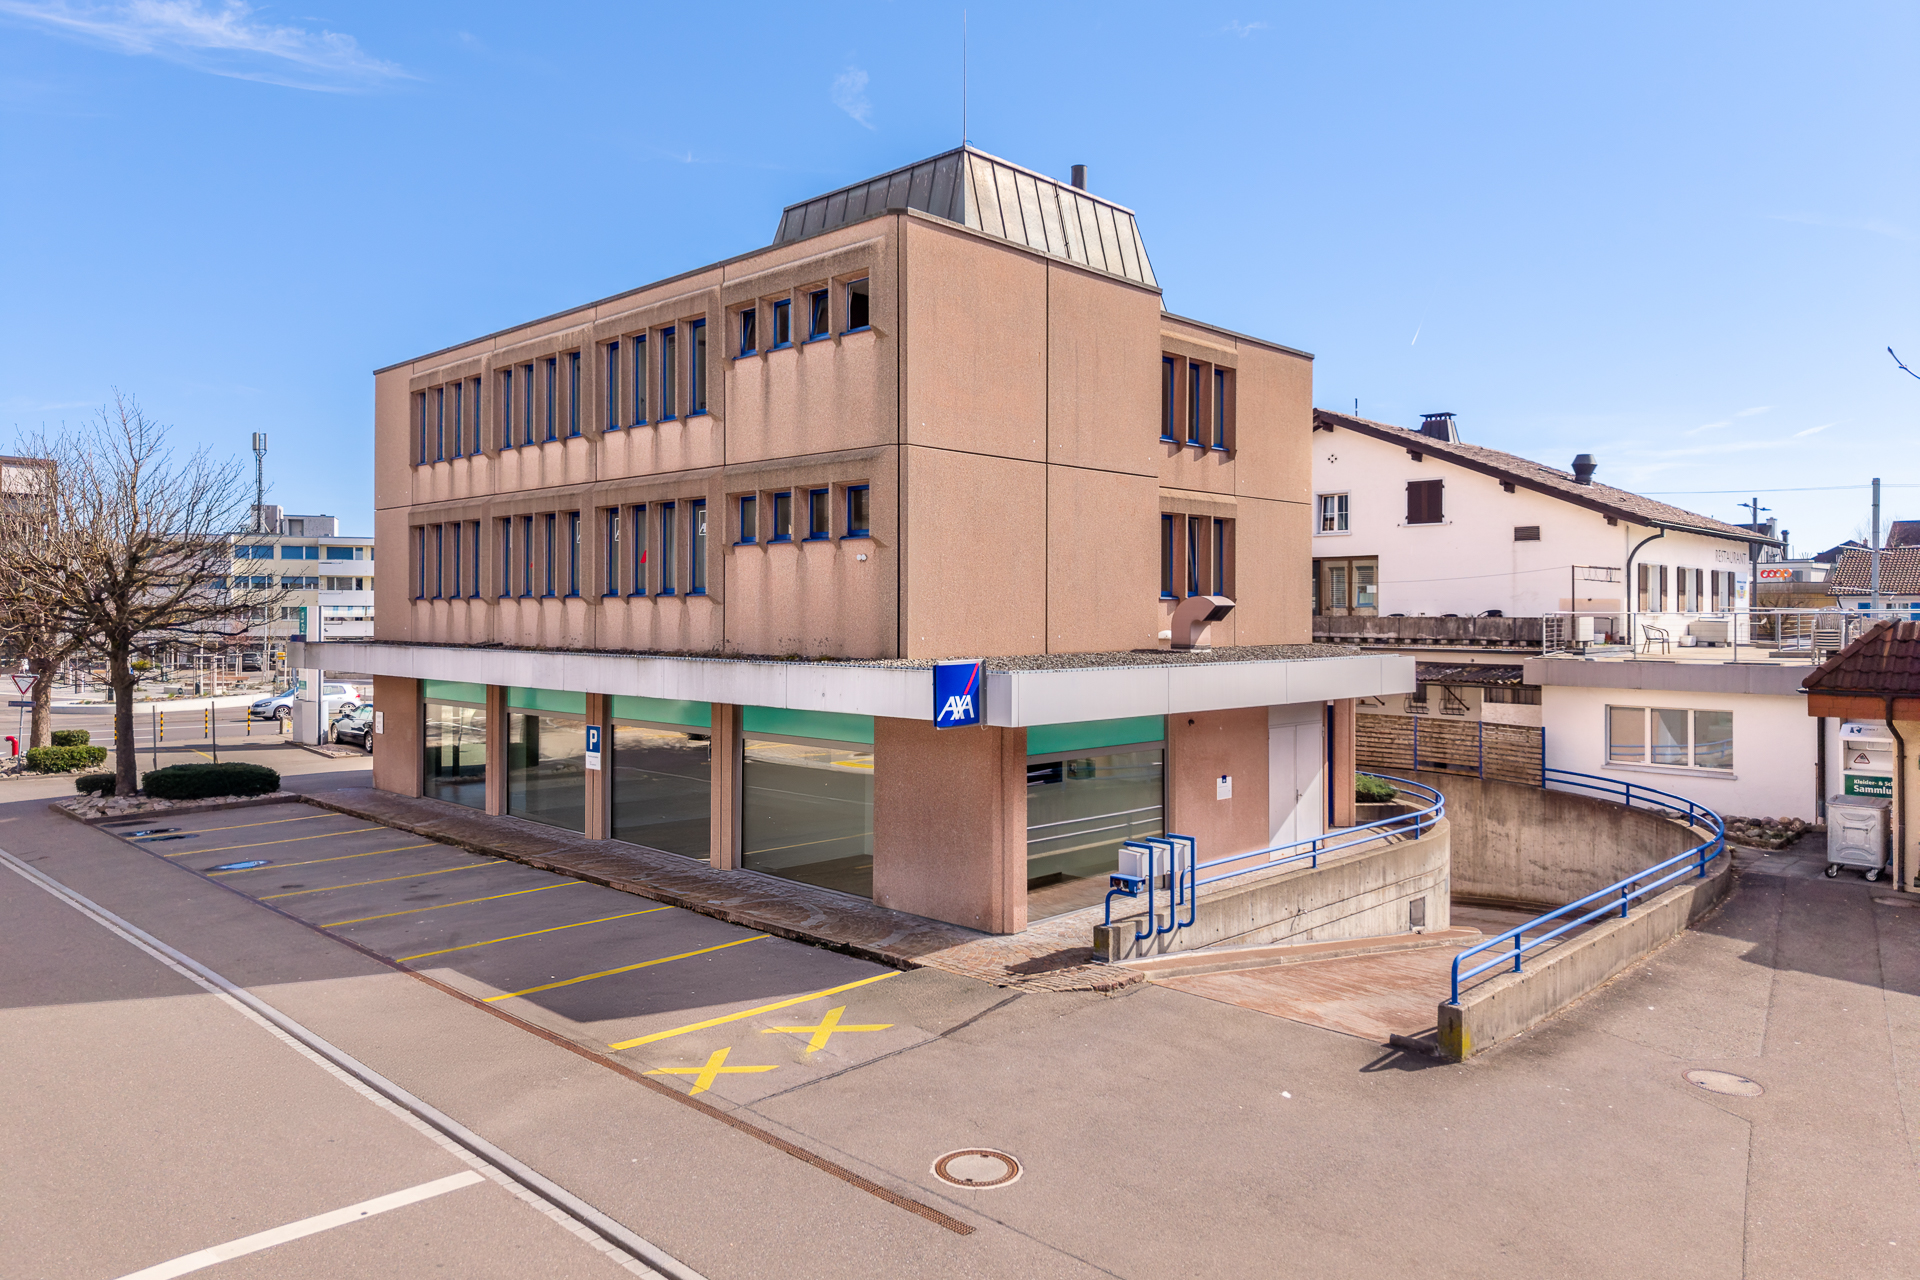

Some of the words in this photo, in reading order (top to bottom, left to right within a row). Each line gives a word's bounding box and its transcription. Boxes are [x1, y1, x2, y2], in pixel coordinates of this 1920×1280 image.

[1715, 550, 1747, 565] RESTAURANT
[1760, 569, 1792, 580] coop
[937, 695, 974, 721] AXA
[590, 729, 598, 750] P
